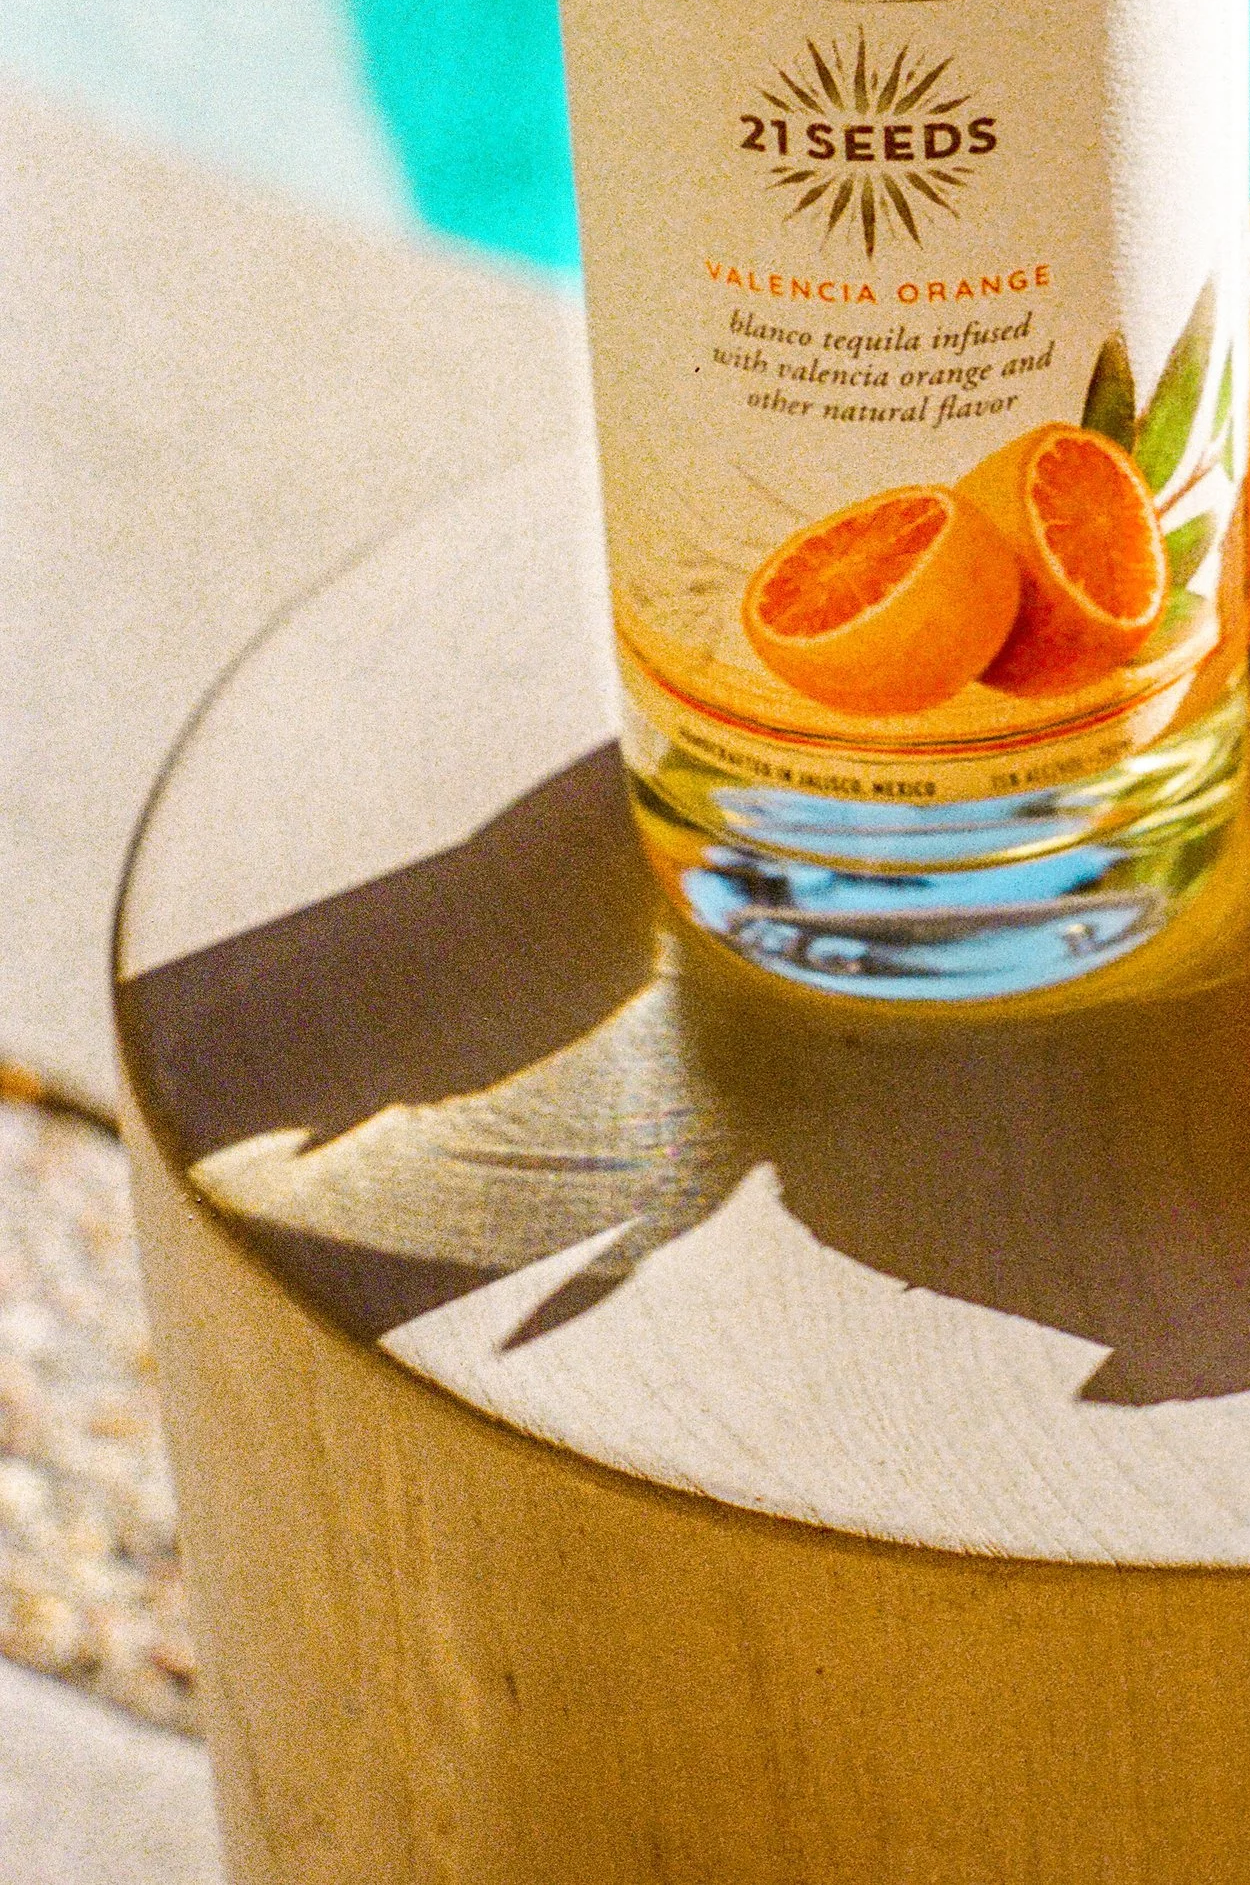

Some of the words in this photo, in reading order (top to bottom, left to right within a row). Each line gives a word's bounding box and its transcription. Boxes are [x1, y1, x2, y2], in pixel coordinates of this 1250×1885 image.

[806, 116, 998, 162] SEEDS
[704, 259, 878, 305] VALENCIA
[896, 263, 1051, 305] ORANGE
[729, 309, 812, 348] blanco
[822, 326, 920, 359] tequila
[931, 311, 1033, 355] infused
[712, 346, 768, 374] with
[777, 357, 889, 388] valencia
[899, 361, 991, 390] orange
[1001, 341, 1055, 375] and
[746, 389, 813, 418] other
[822, 395, 928, 423] natural
[933, 391, 1020, 428] flavor
[871, 780, 936, 798] MEXICO
